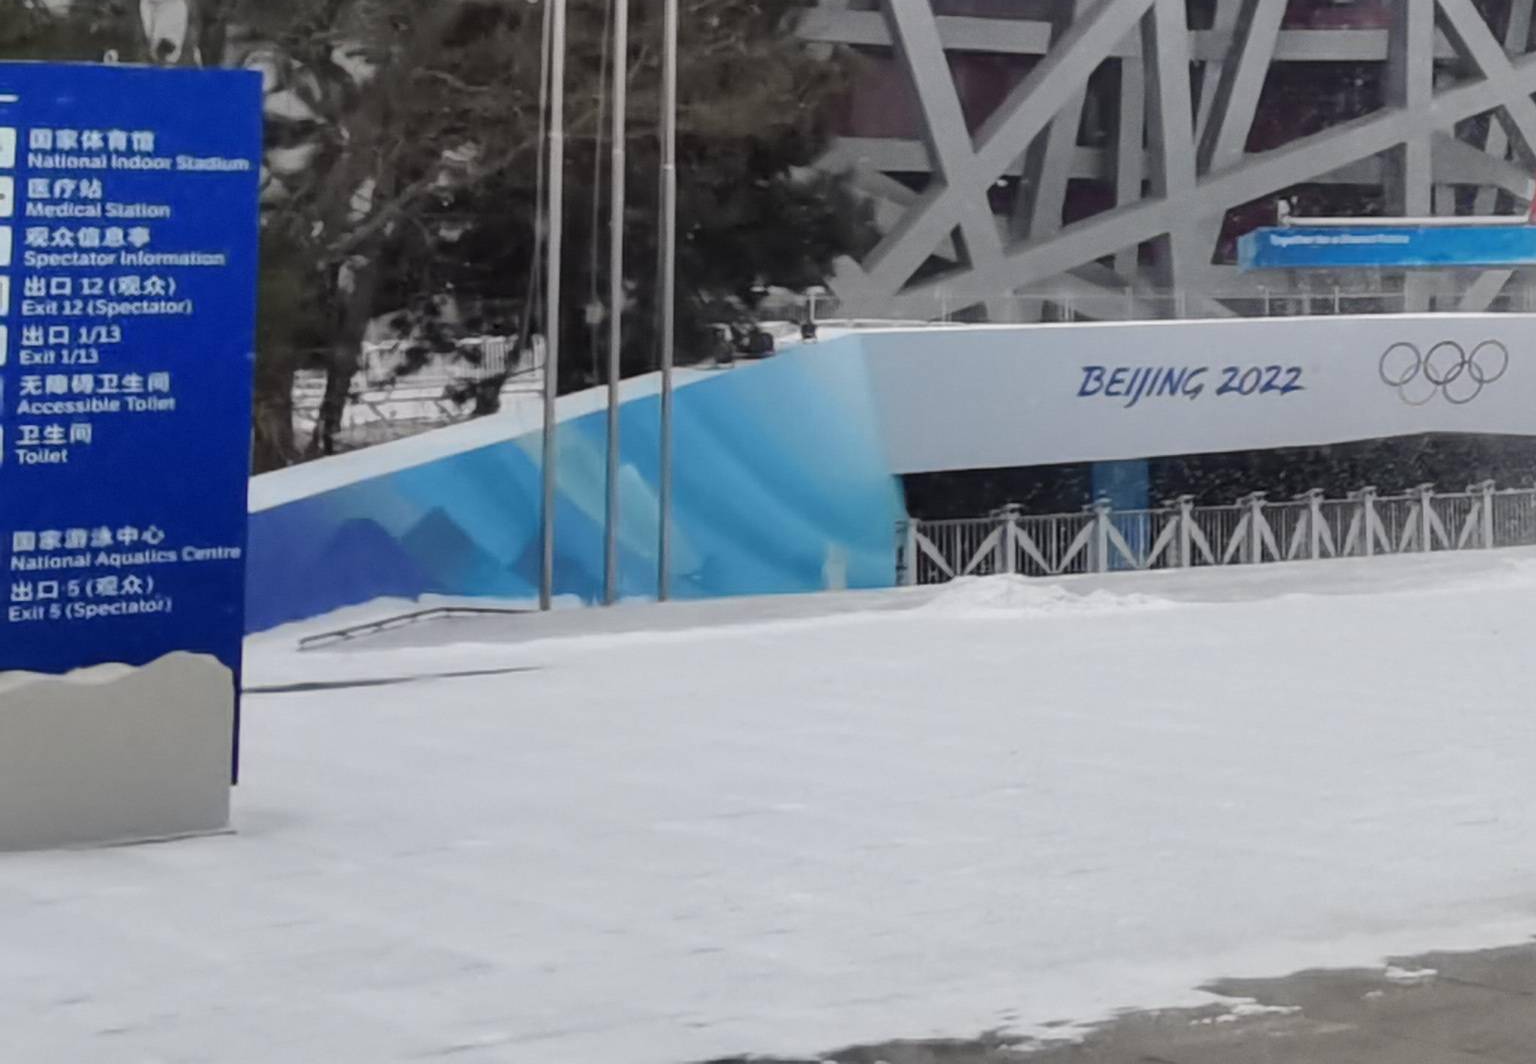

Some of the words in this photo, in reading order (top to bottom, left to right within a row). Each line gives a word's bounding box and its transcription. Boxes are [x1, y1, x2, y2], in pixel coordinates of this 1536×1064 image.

[29, 128, 155, 152] 国家体育馆
[28, 153, 107, 169] National
[111, 154, 171, 170] Indoor
[175, 155, 250, 171] Stadium
[27, 178, 103, 200] 医疗站
[25, 202, 101, 218] Medical
[105, 202, 170, 218] Station
[24, 226, 150, 248] 观众信息亭
[24, 251, 115, 267] Spectator
[120, 251, 225, 266] Information
[24, 276, 72, 297] 出口
[81, 277, 104, 296] 12
[22, 300, 58, 316] Exit
[63, 300, 83, 315] 12
[87, 299, 193, 318] (Spectator)
[21, 325, 69, 346] 出口
[78, 325, 121, 343] 1/13
[19, 350, 56, 365] Exit
[61, 349, 99, 364] 1/13
[19, 372, 170, 395] 无障碍卫生间
[1077, 366, 1209, 408] BEIJING
[1216, 365, 1307, 396] 2022
[17, 398, 120, 415] Accessible
[126, 397, 175, 411] Toilet
[16, 423, 92, 445] 卫生间
[16, 449, 67, 465] Toilet
[12, 525, 165, 552] 国家游泳中心
[11, 553, 90, 570] National
[94, 549, 177, 567] Aquatics
[182, 546, 241, 562] Centre
[10, 581, 59, 602] 出口
[67, 579, 80, 596] 5
[8, 604, 44, 622] Exit
[51, 603, 61, 619] 5
[66, 598, 172, 620] (Spectator)
